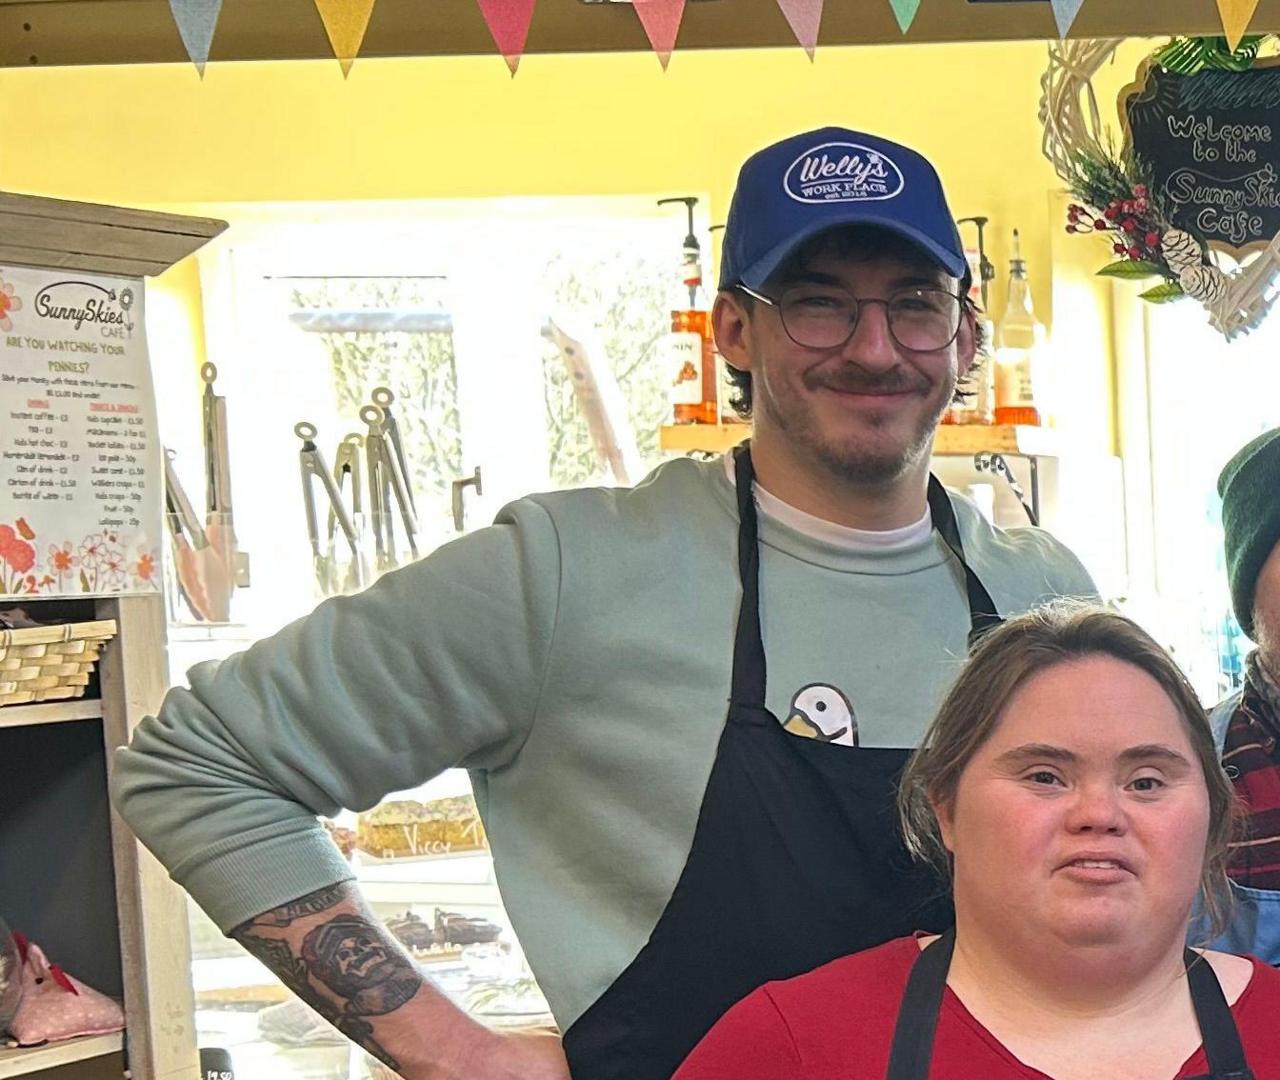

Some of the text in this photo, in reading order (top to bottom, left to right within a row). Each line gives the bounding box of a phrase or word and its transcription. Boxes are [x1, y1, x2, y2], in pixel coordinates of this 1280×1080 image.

[1168, 115, 1272, 142] Welcome
[1193, 138, 1256, 163] to the
[802, 183, 842, 197] WORK
[1197, 208, 1263, 243] Cafe
